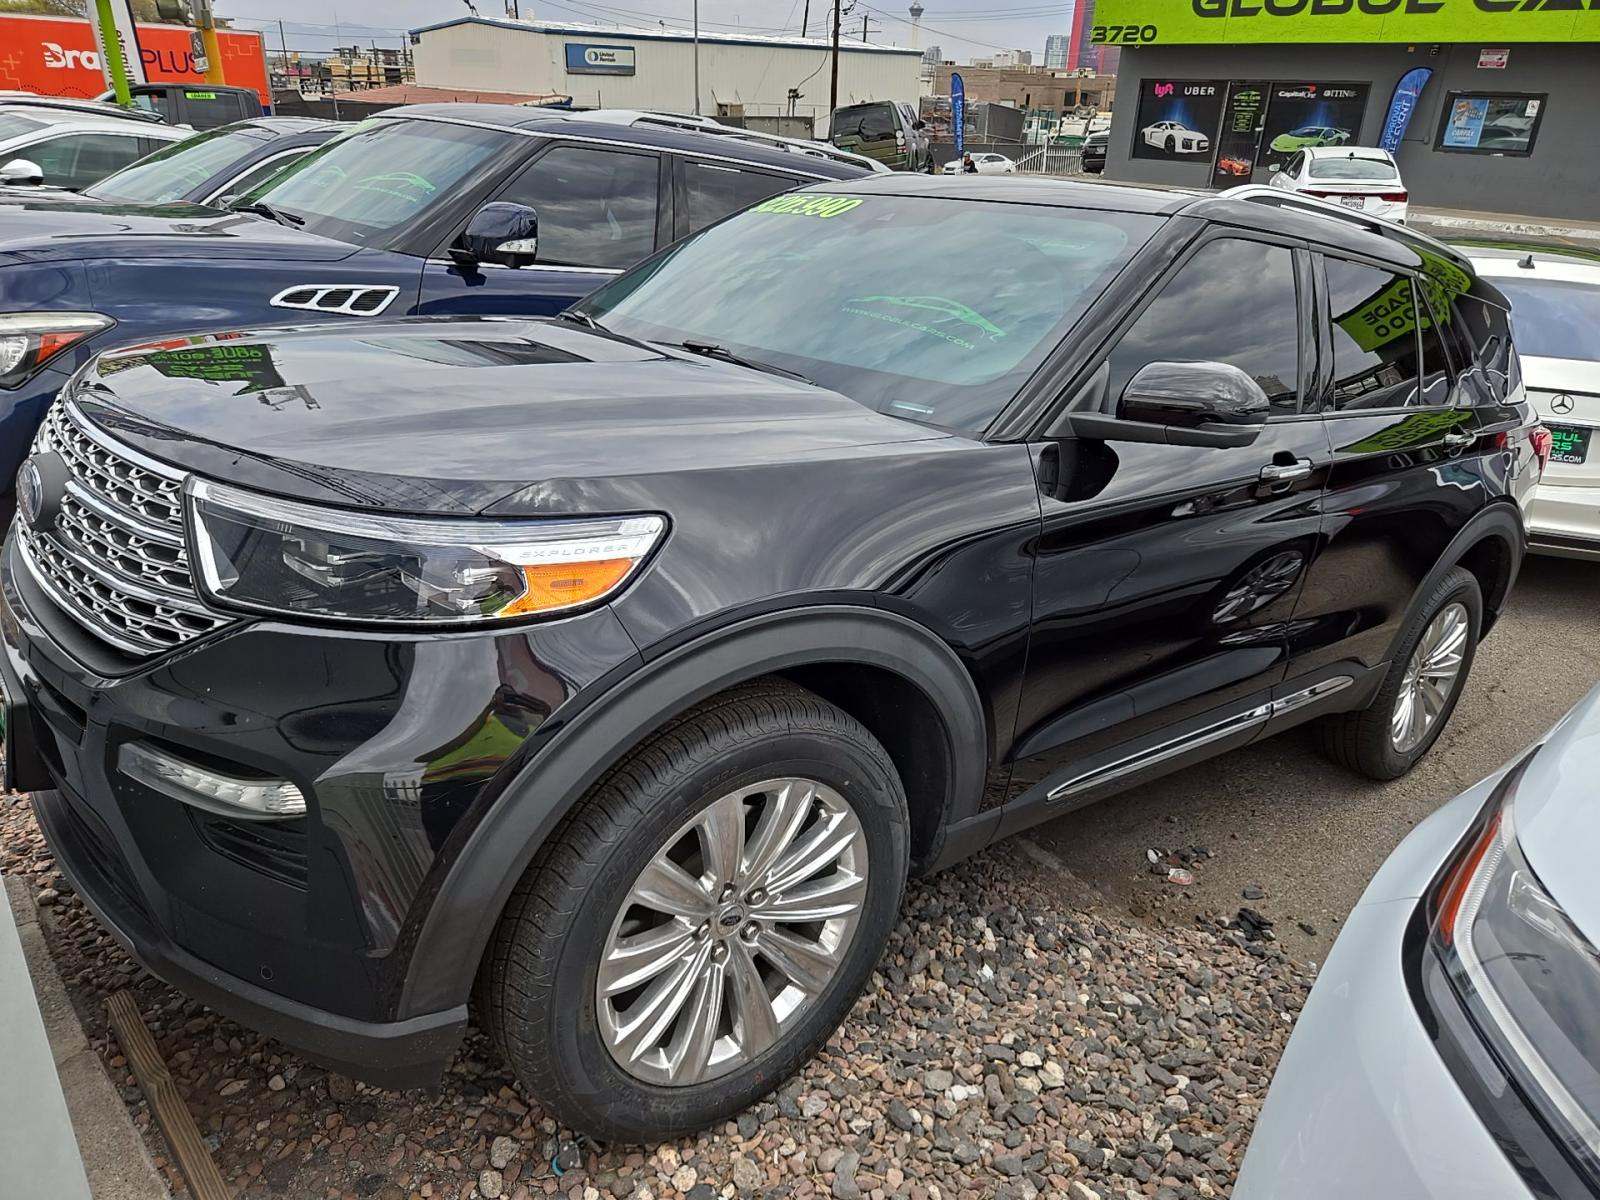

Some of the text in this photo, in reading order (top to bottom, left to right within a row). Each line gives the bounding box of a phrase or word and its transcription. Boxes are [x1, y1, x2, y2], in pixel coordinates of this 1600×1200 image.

[1092, 25, 1158, 43] 3720
[41, 42, 102, 70] Bra
[1184, 86, 1215, 96] UBER
[1551, 431, 1583, 443] BUL
[1551, 442, 1573, 451] RS
[1550, 454, 1582, 463] RS.COM
[519, 544, 628, 559] EXPLORER
